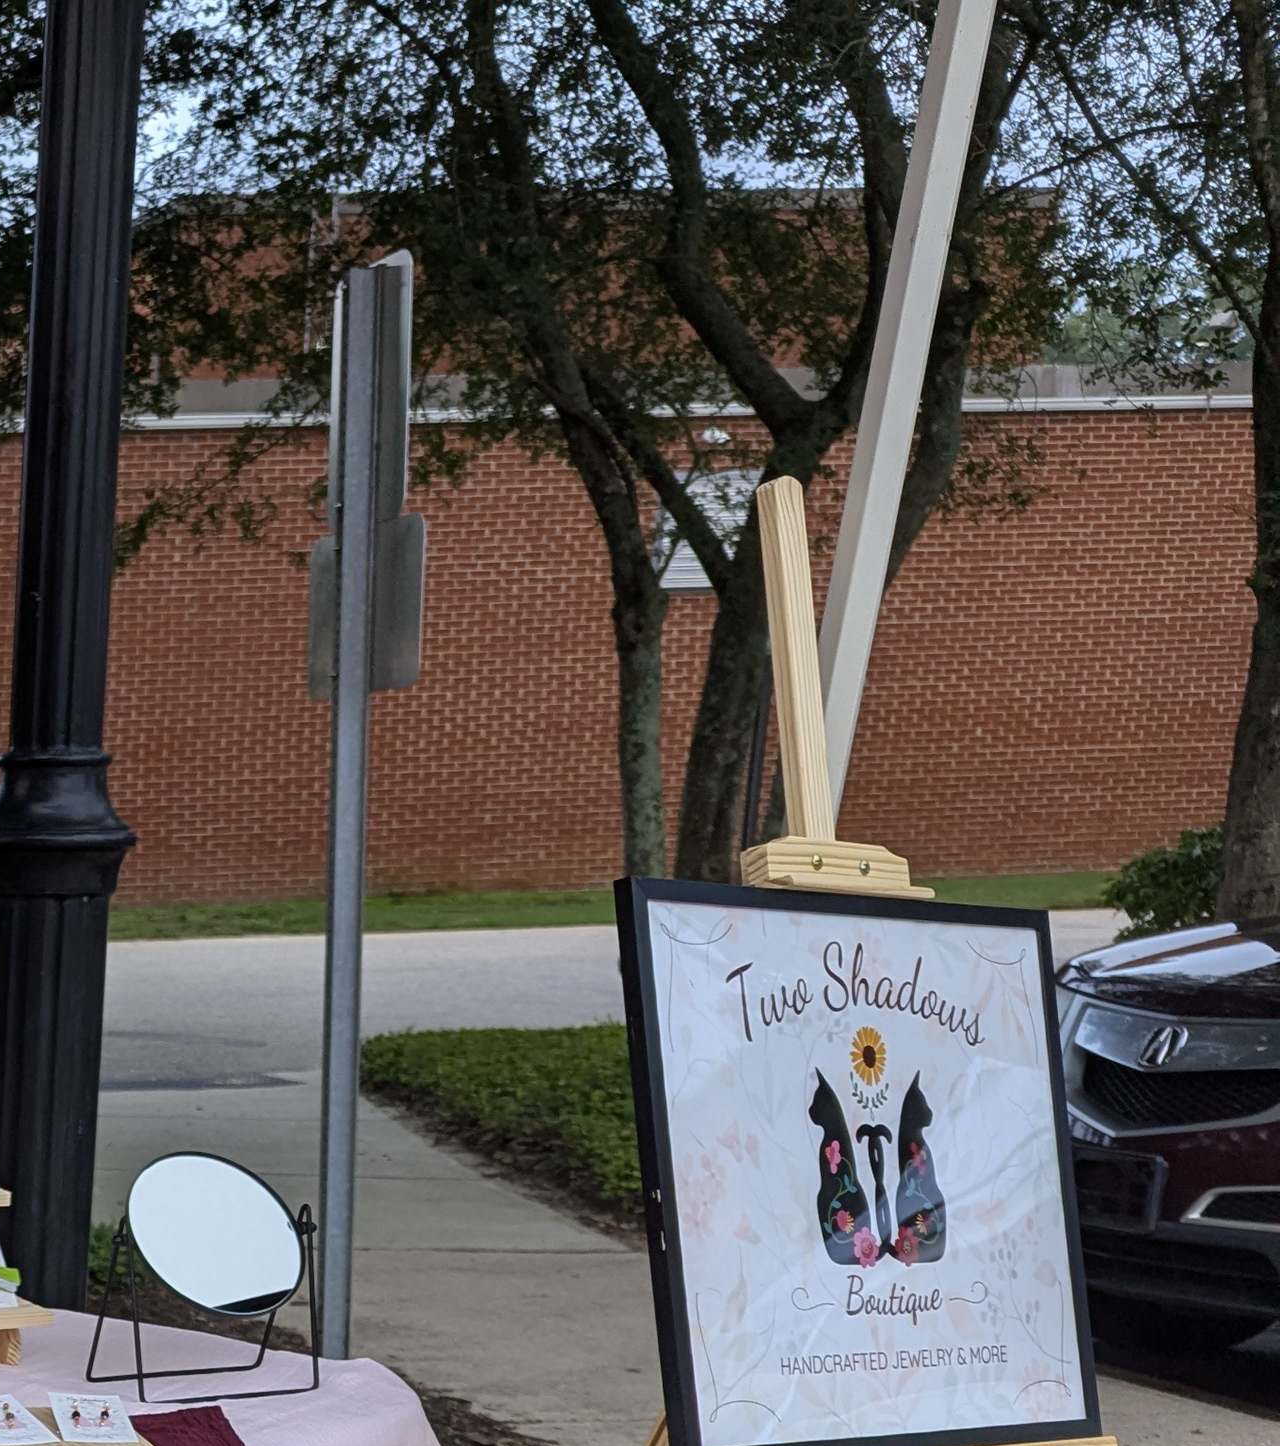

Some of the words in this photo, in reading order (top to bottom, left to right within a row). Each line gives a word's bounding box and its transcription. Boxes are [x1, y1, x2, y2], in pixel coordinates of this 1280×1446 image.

[726, 961, 814, 1042] Two
[822, 941, 985, 1046] Shadows
[846, 1274, 942, 1325] Boutique
[780, 1350, 889, 1376] HANDCRAFTED
[892, 1347, 953, 1372] JEWELRY
[956, 1346, 968, 1366] &
[969, 1345, 1008, 1365] MORE
